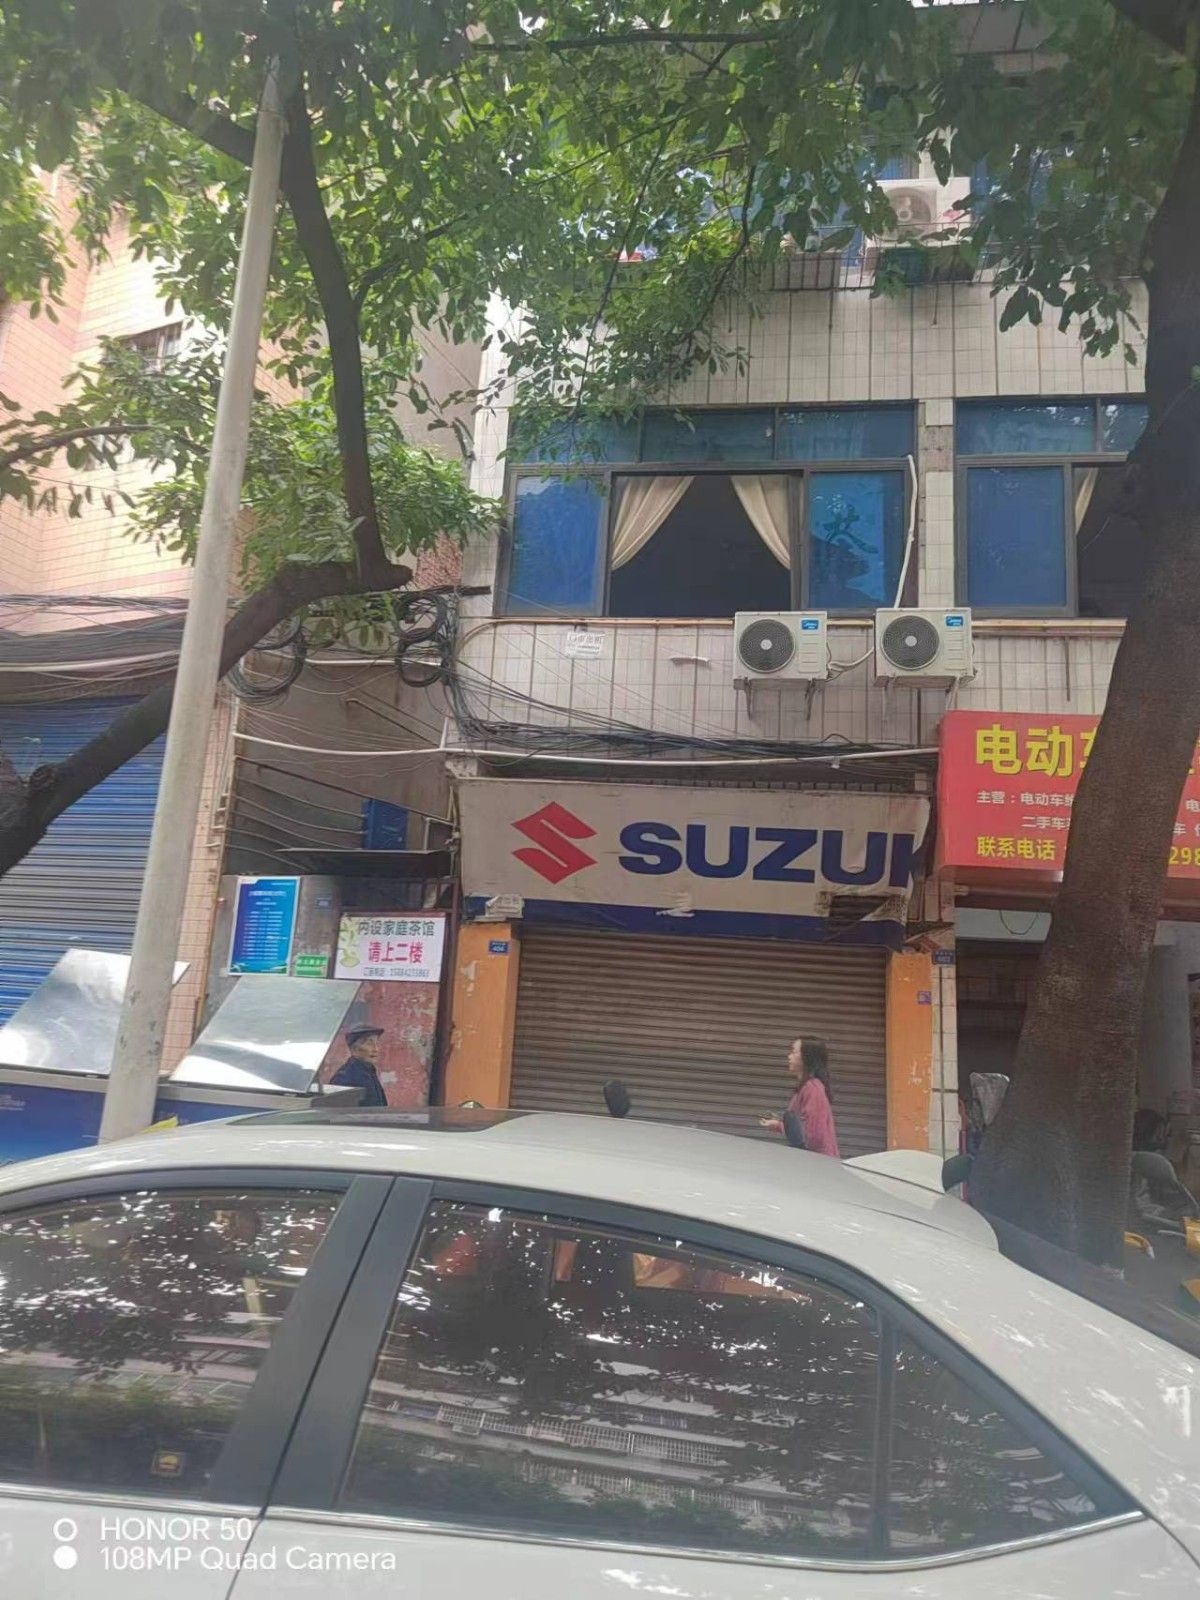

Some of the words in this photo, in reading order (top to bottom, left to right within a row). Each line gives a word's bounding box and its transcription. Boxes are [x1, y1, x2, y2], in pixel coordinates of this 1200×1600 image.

[976, 837, 1056, 861] 联系电话
[358, 920, 435, 936] 内设家庭茶馆
[368, 941, 423, 963] 请上二楼
